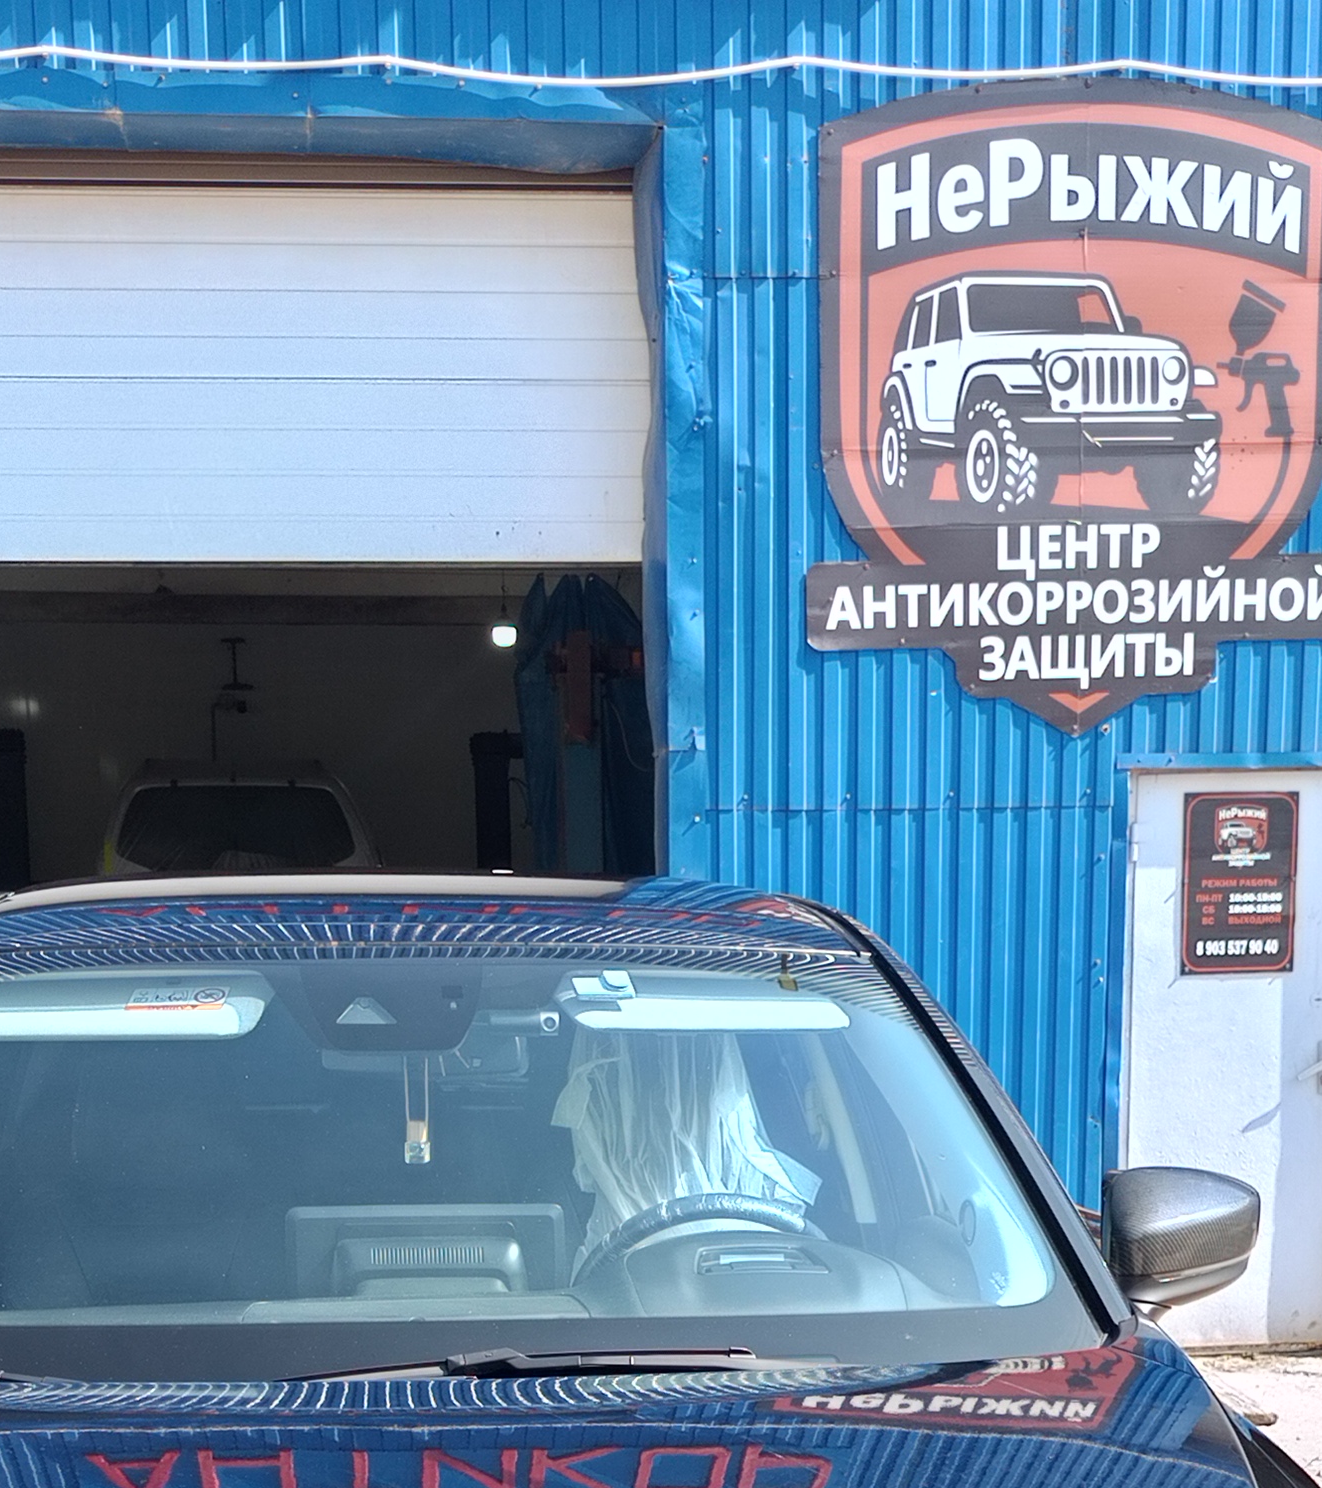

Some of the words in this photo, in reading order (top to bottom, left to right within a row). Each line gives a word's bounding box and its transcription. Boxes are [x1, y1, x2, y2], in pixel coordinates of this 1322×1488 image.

[876, 137, 1303, 254] НеРыжий
[995, 523, 1162, 580] ЦЕНТР
[977, 632, 1196, 690] ЗАЩИТЫ
[1201, 878, 1237, 888] РЕЖИМ
[1239, 877, 1278, 887] РАБОТЫ
[1195, 892, 1224, 903] ПН-ПТ
[1202, 905, 1216, 914] СБ
[1195, 940, 1204, 957] 8
[1205, 940, 1226, 956] 903
[1227, 939, 1248, 955] 537
[1248, 938, 1264, 955] 90
[1264, 938, 1279, 954] 40
